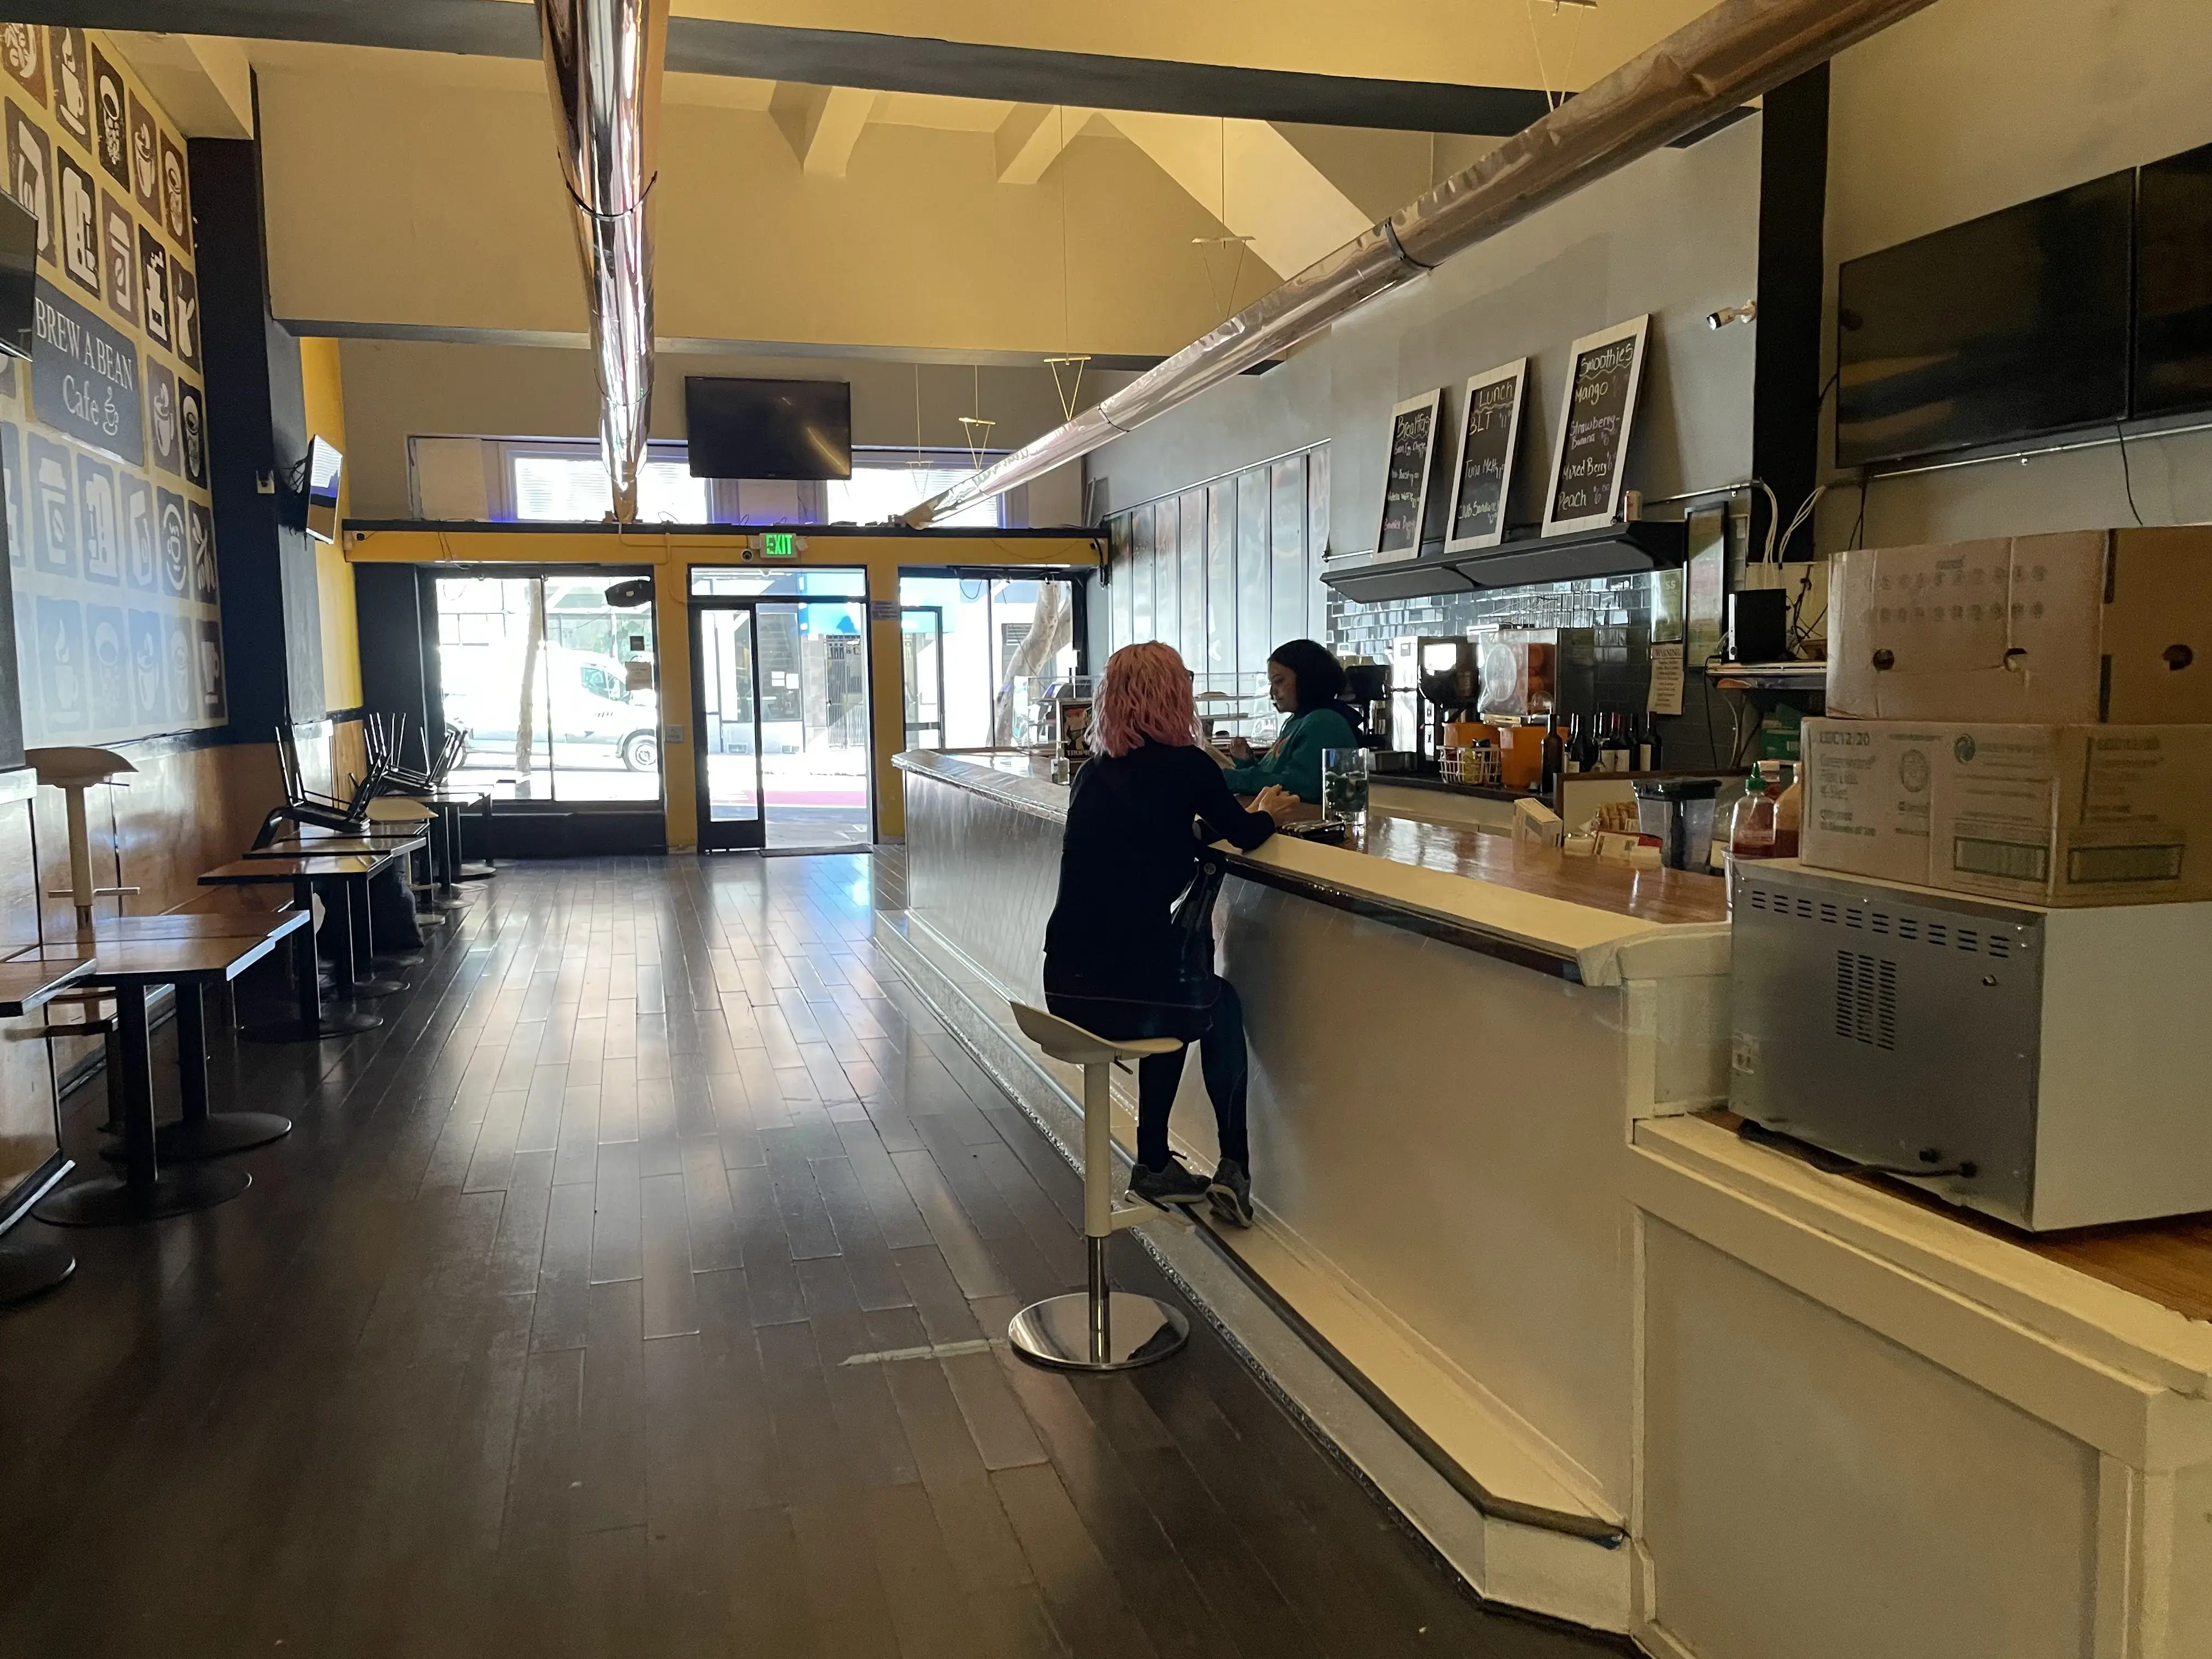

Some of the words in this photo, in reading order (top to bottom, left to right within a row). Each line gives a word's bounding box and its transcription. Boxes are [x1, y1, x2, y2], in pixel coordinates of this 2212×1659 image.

[35, 297, 81, 360] BREW
[84, 331, 95, 370] A
[95, 337, 134, 392] BEAN
[1579, 343, 1633, 377] Smoothies
[63, 375, 99, 425] Cafe
[1479, 381, 1513, 408] Lunch
[1575, 382, 1609, 405] Mango
[1396, 413, 1431, 438] Breakfas
[1469, 411, 1493, 435] BLT
[1465, 459, 1481, 479] Tuna
[1562, 459, 1585, 481] Mixed
[1587, 457, 1607, 477] Berry
[1558, 489, 1587, 512] Peach
[766, 534, 792, 555] EXIT
